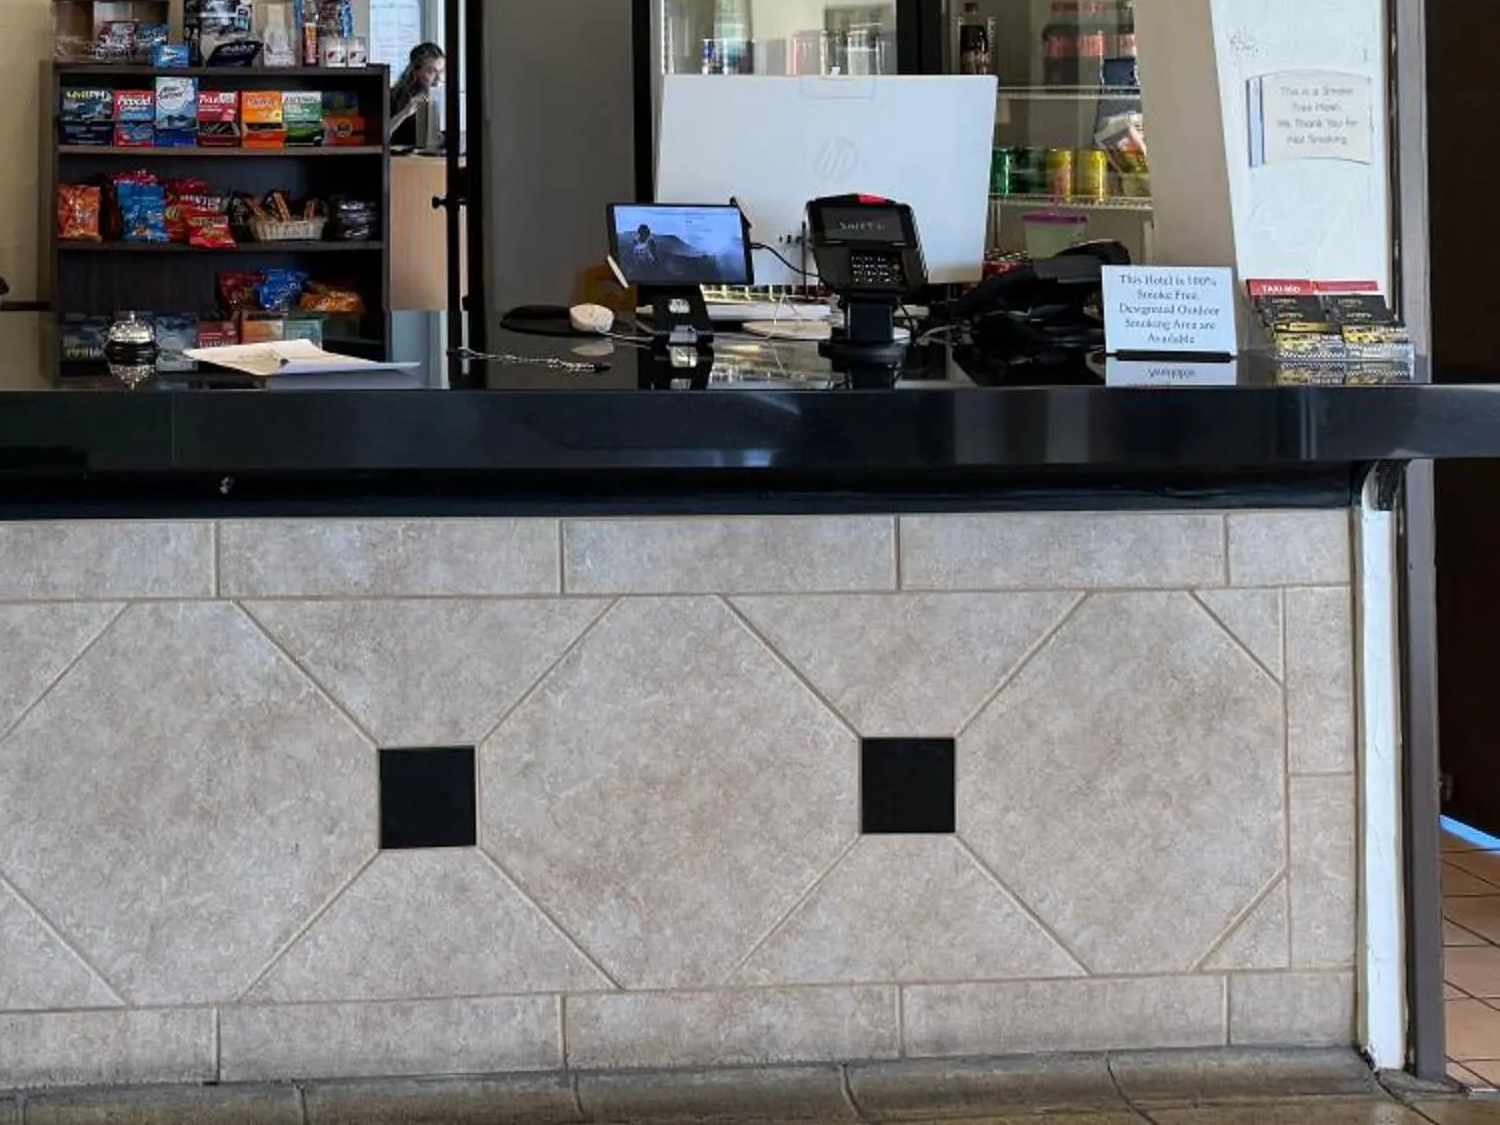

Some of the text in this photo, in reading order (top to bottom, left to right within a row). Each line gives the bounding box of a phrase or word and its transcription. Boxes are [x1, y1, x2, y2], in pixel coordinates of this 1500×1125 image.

[1119, 274, 1217, 287] This Hotel is 100%
[1138, 289, 1172, 300] Smoke
[1119, 303, 1219, 315] Designated Outdoor
[1125, 318, 1215, 331] Smoking Area are
[1147, 333, 1195, 344] Available
